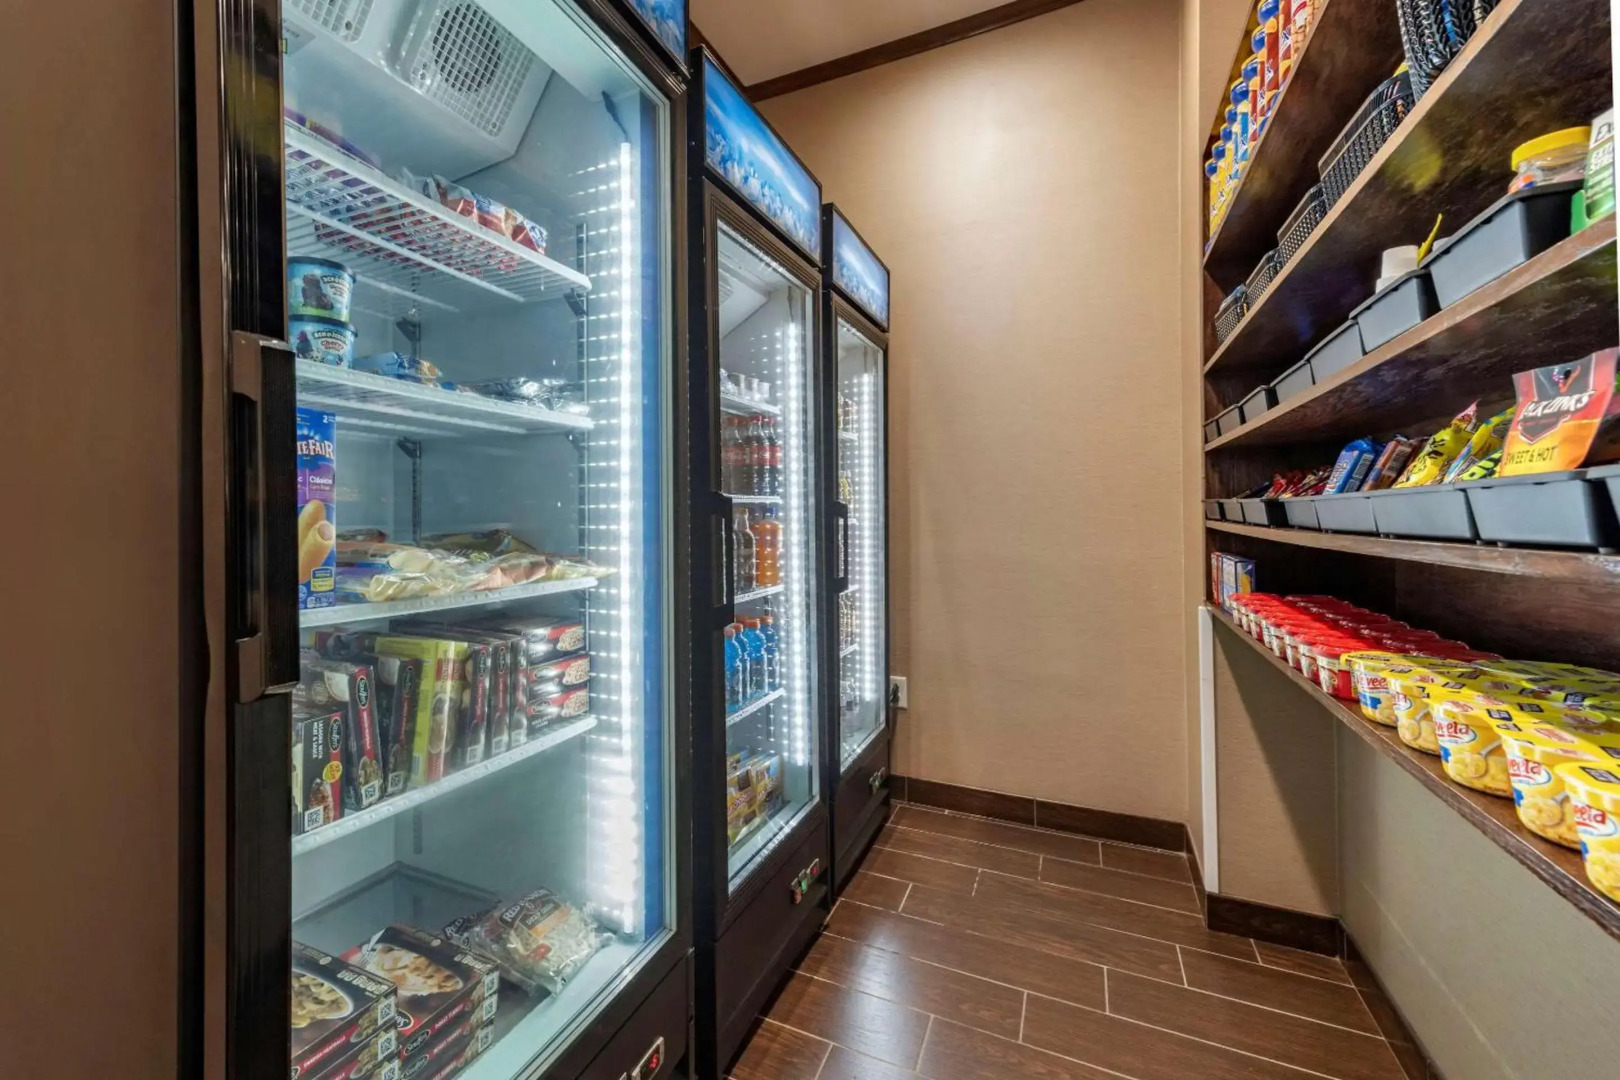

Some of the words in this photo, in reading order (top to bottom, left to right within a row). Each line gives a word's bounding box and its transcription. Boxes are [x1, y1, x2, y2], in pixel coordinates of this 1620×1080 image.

[323, 415, 328, 424] 2
[1537, 446, 1559, 461] HOT
[503, 904, 521, 921] RED
[444, 918, 464, 937] RED
